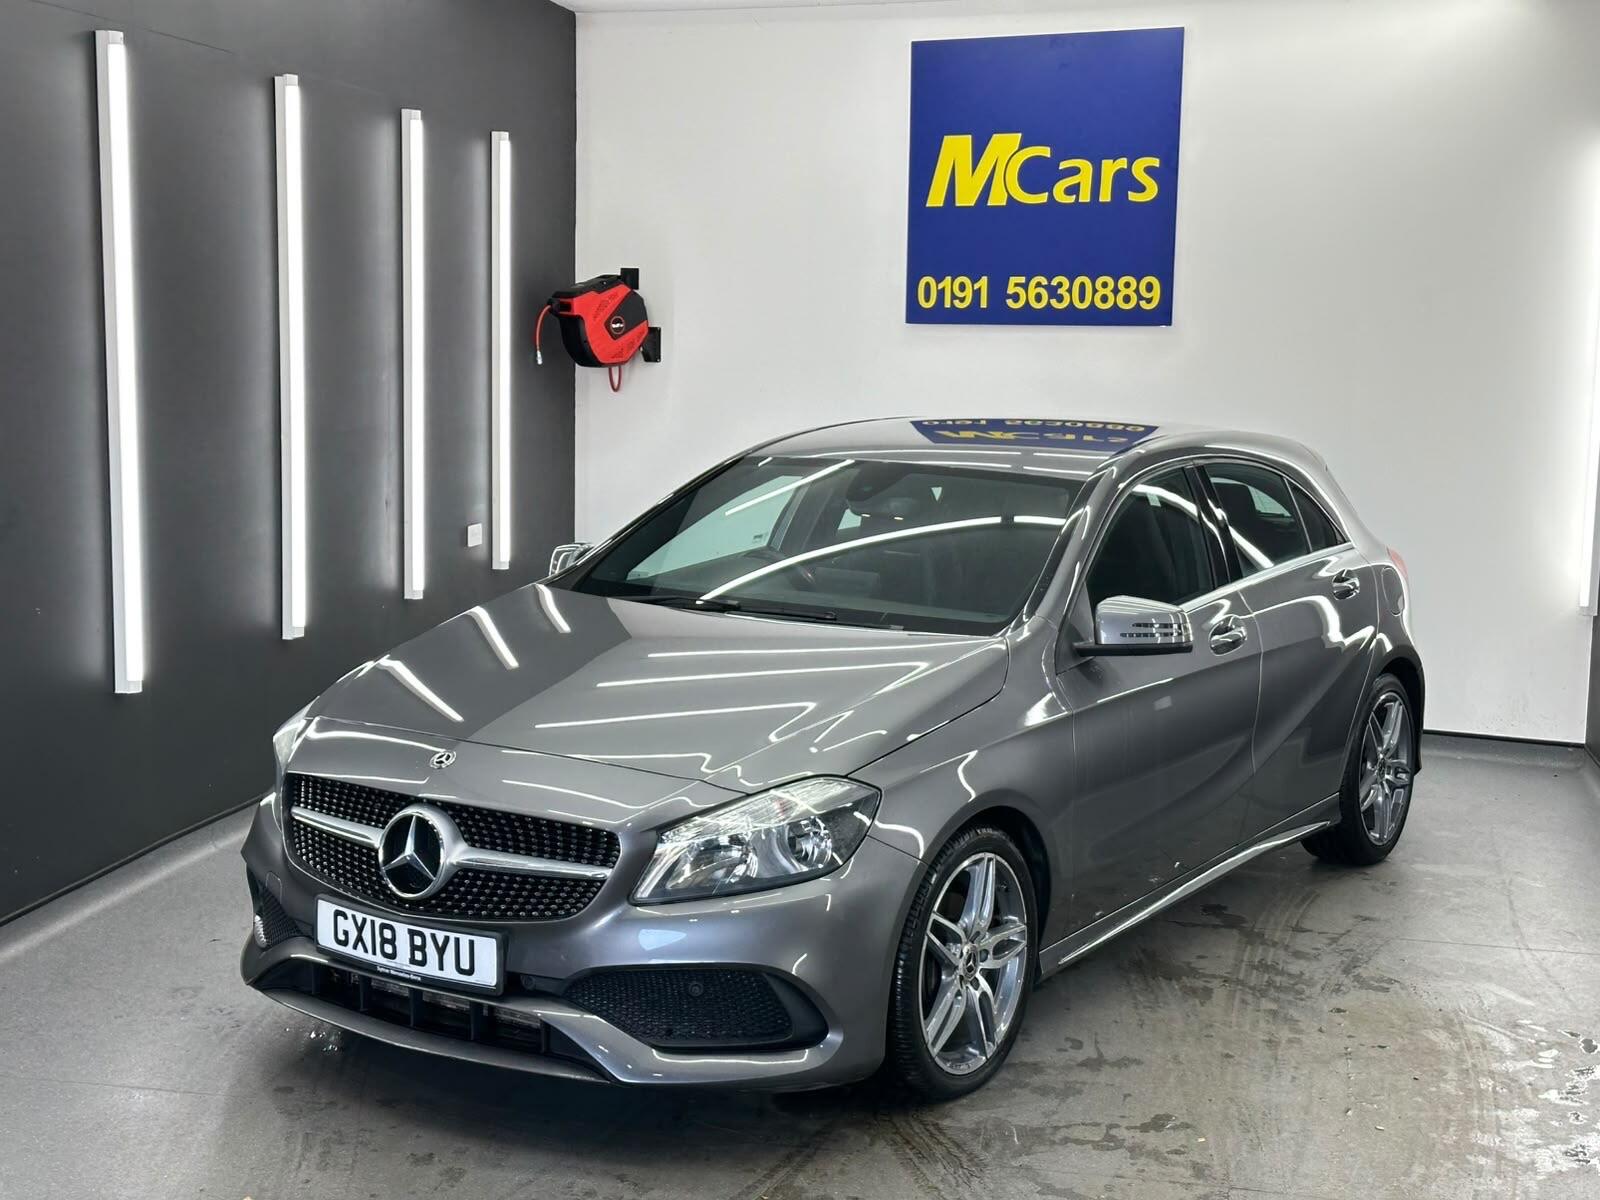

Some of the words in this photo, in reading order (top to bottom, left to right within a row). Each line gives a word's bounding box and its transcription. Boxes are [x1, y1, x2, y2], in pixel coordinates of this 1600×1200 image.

[926, 132, 1161, 208] MCars
[917, 275, 988, 309] 0191
[1006, 275, 1161, 310] 5630889
[333, 909, 398, 961] GX18
[407, 928, 475, 977] BYU
